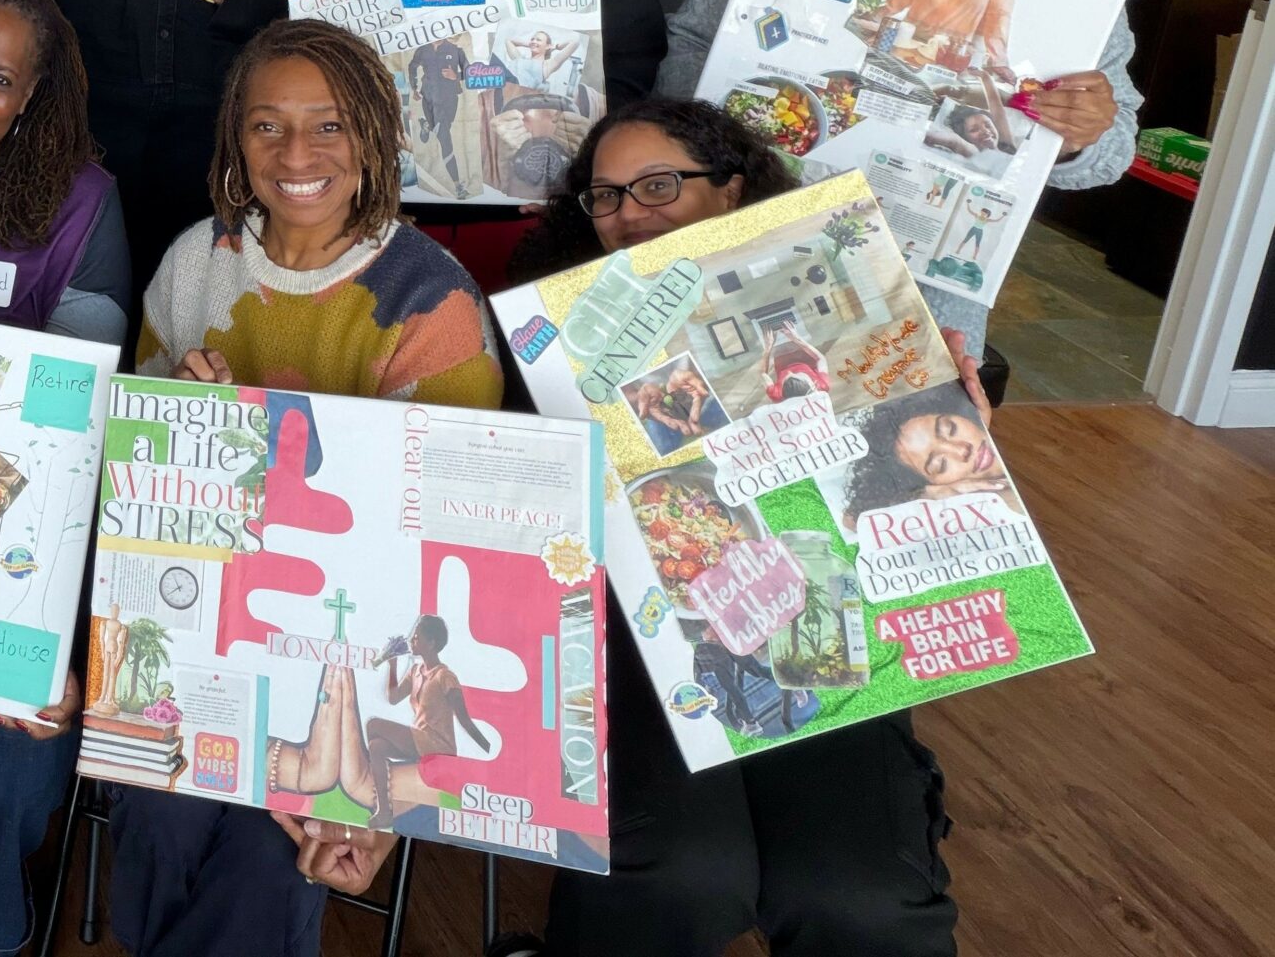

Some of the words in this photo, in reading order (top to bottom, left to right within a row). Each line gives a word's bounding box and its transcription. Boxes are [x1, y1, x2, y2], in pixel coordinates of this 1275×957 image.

[376, 3, 500, 55] Patience
[468, 62, 503, 76] Have
[468, 74, 504, 88] FAITH
[511, 316, 543, 351] Have
[520, 324, 558, 362] FAITH
[581, 257, 703, 404] CENTERED
[31, 365, 89, 394] Retire
[110, 382, 268, 435] Imagine
[706, 424, 766, 458] Keep
[768, 397, 829, 433] Body
[133, 436, 154, 463] a
[169, 431, 239, 472] Life
[404, 406, 429, 480] Clear
[718, 432, 865, 504] TOGETHER
[730, 441, 777, 474] And
[779, 417, 835, 455] Soul
[108, 463, 263, 514] Without
[402, 487, 422, 532] out
[100, 499, 264, 555] STRESS
[443, 499, 495, 520] INNER
[501, 508, 562, 530] PEACE!
[864, 498, 1006, 550] Relax:
[859, 546, 918, 575] Your
[919, 522, 1033, 564] HEALTH
[870, 561, 979, 597] Depends
[986, 552, 1011, 572] on
[1018, 544, 1042, 567] it
[692, 541, 805, 622] Healthy
[716, 578, 804, 653] hobbies
[879, 616, 895, 641] A
[900, 591, 1004, 635] HEALTHY
[910, 621, 986, 654] BRAIN
[267, 632, 378, 670] LONGER
[904, 647, 958, 678] FOR
[958, 636, 1011, 667] LIFE
[560, 592, 598, 799] VACATION
[196, 756, 235, 776] VIBES
[199, 737, 235, 761] GOD
[463, 784, 534, 823] Sleep
[441, 813, 557, 858] BETTER.
